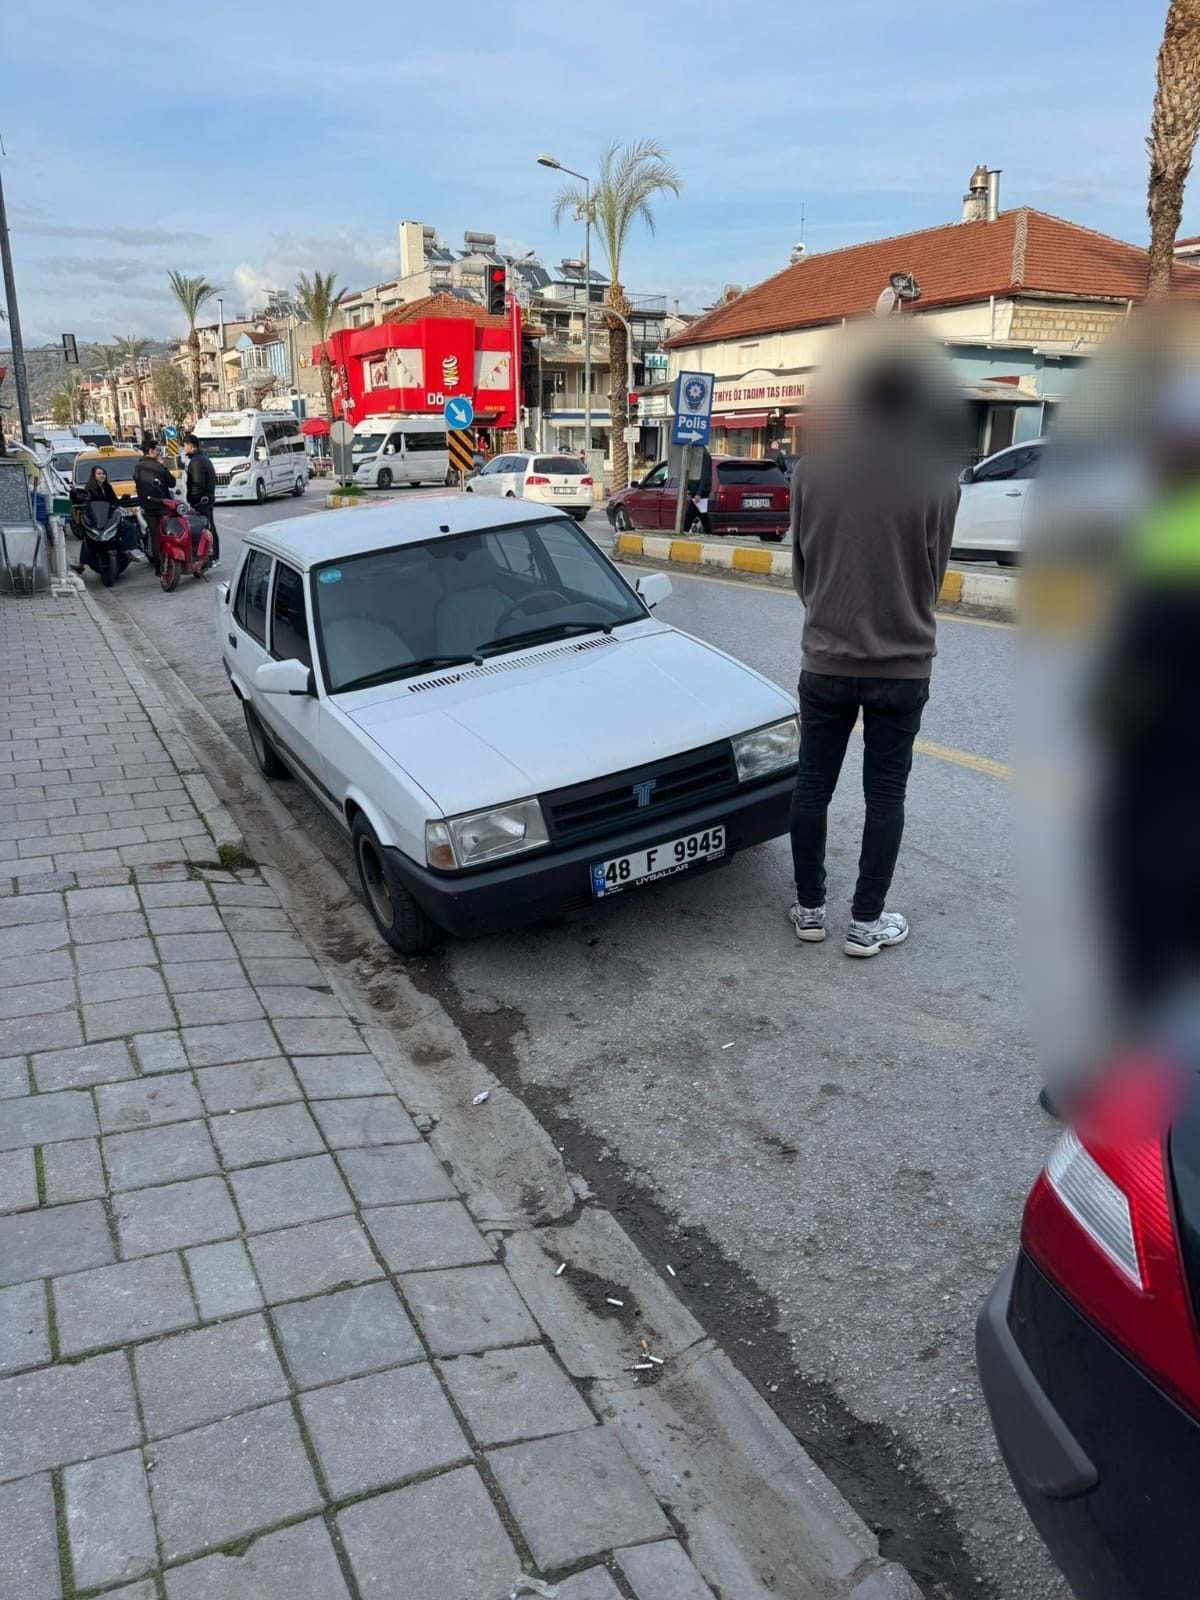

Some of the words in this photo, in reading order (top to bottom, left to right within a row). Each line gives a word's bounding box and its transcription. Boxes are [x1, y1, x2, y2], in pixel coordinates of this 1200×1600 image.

[734, 387, 742, 400] ÖZ
[743, 387, 765, 400] TADIM
[767, 386, 780, 400] TAŞ
[782, 384, 805, 397] FIRINI
[678, 415, 707, 430] Polis
[605, 859, 631, 883] 48
[646, 849, 658, 872] F
[674, 828, 723, 862] 9945
[635, 863, 689, 886] UYSALLAR
